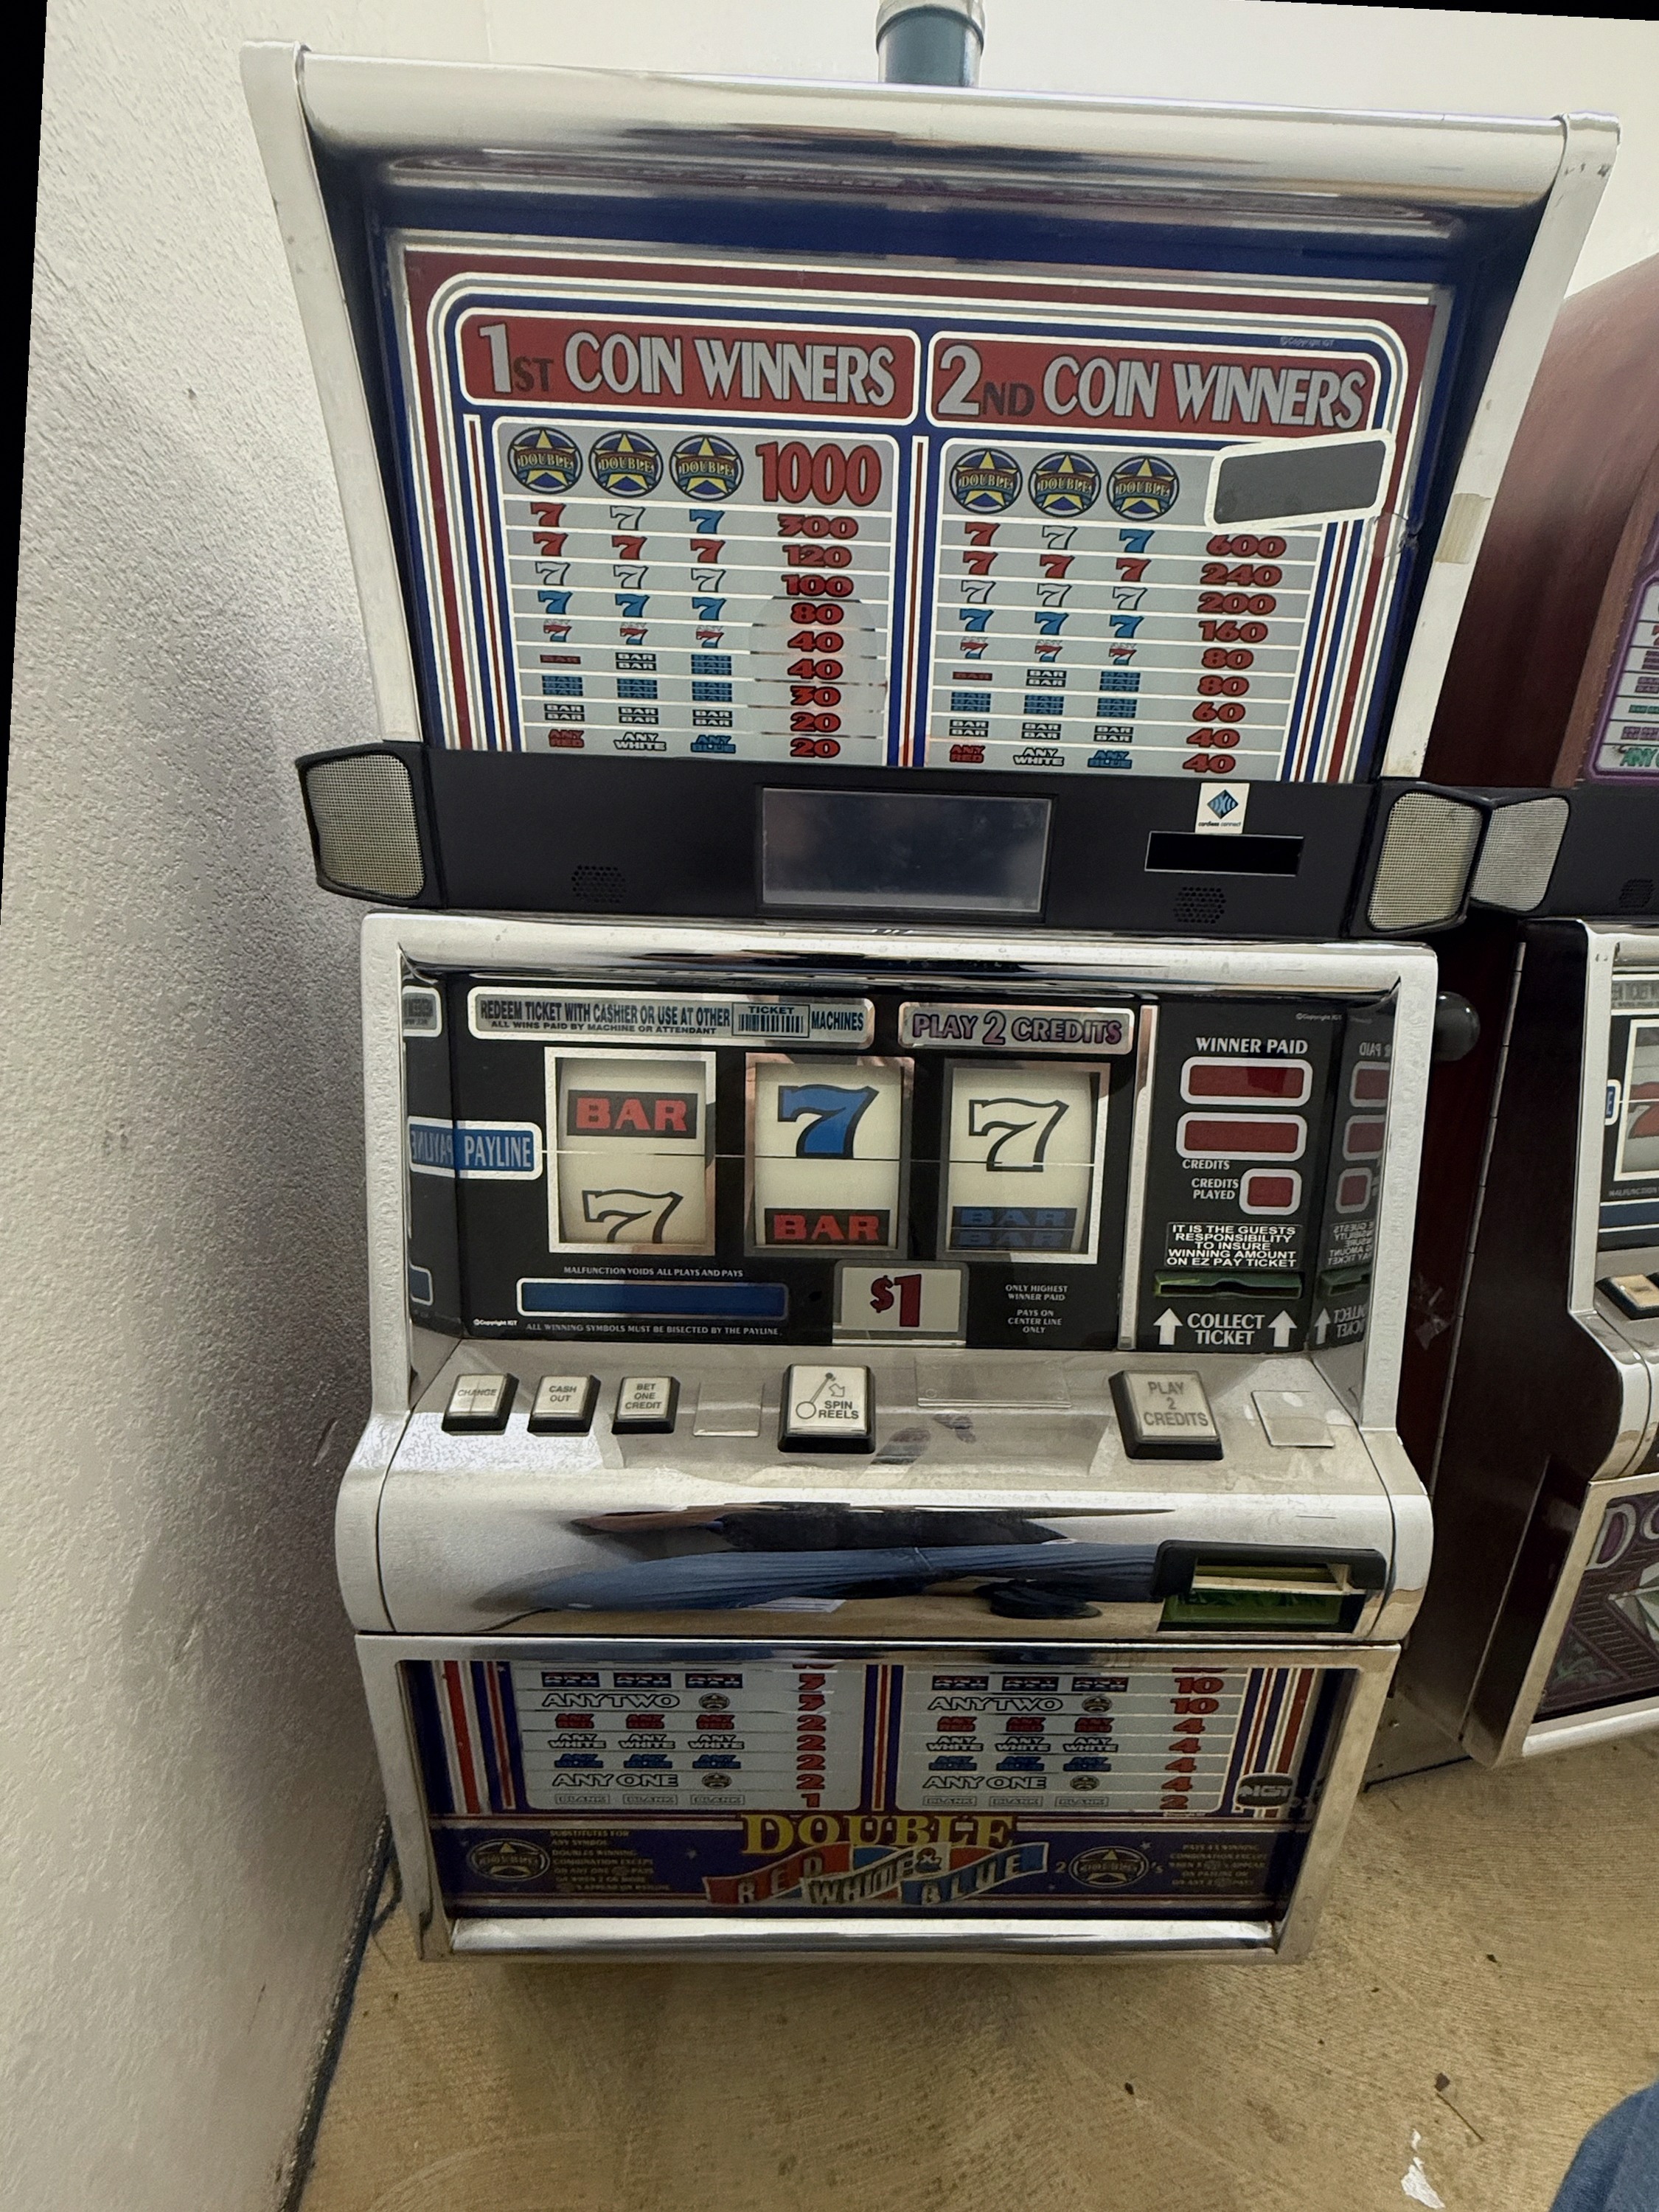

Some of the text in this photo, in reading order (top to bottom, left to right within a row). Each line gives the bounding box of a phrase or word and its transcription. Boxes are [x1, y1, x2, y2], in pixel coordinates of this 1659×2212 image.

[565, 332, 683, 395] COIN
[694, 339, 895, 406] WINNERS
[1043, 355, 1161, 419] COIN
[1173, 363, 1366, 429] WINNERS
[519, 454, 734, 476] DOUBLE DOUBLE DOUBLE
[756, 442, 881, 506] 1000
[960, 473, 1169, 497] DOUBLE DOUBLE DOUBLE
[778, 513, 858, 539] 300
[782, 544, 852, 568] 120
[1206, 535, 1287, 558] 600
[1200, 563, 1282, 587] 240
[782, 574, 854, 597] 100
[1197, 591, 1276, 616] 200
[790, 602, 844, 625] 80
[1198, 620, 1268, 643] 160
[787, 630, 844, 653] 40
[1202, 647, 1253, 670] 80
[787, 658, 843, 680] 40
[1197, 675, 1249, 696] 80
[790, 685, 841, 707] 30
[1192, 702, 1245, 723] 60
[790, 712, 841, 733] 20
[613, 740, 667, 751] WHITE
[623, 731, 658, 741] ANY
[1186, 728, 1240, 748] 40
[790, 737, 841, 758] 20
[1023, 748, 1058, 757] ANY
[1093, 750, 1130, 759] ANY
[1013, 756, 1064, 767] WHITE
[1183, 754, 1236, 773] 40
[481, 1001, 730, 1027] REDEEM TICKET WITH CASHIER OR USE AT OTHER
[748, 1006, 794, 1015] TICKET
[655, 1026, 716, 1034] ATTENDANT
[812, 1011, 864, 1031] MACHINES
[913, 1010, 1122, 1046] PLAY 2 CREDITS
[1196, 1037, 1308, 1054] WINNER PAID
[575, 1097, 687, 1133] BAR
[776, 1083, 880, 1158] 7
[967, 1098, 1070, 1172] 7
[465, 1135, 531, 1167] PAYLINE
[1182, 1159, 1230, 1169] CREDITS
[1192, 1178, 1239, 1189] CREDITS
[1193, 1190, 1236, 1200] PLAYED
[582, 1188, 684, 1245] 7
[959, 1208, 1070, 1228] BAR
[773, 1213, 879, 1245] BAR
[1172, 1225, 1296, 1234] IT IS THE GUESTS
[1175, 1234, 1293, 1243] RESPONSIBILITY
[957, 1230, 1068, 1249] BAR
[1218, 1242, 1271, 1251] INSURE
[1168, 1249, 1231, 1258] WINNING
[1192, 1258, 1209, 1266] EZ
[1214, 1259, 1243, 1267] PAY
[1247, 1259, 1296, 1267] TICKET
[563, 1266, 626, 1275] MALFUNCTION
[870, 1274, 922, 1327] $1
[1187, 1313, 1265, 1330] COLLECT
[1195, 1330, 1255, 1345] TICKET
[457, 1388, 497, 1397] CHANGE
[549, 1385, 577, 1394] CASH
[1147, 1382, 1184, 1394] PLAY
[625, 1401, 662, 1410] CREDIT
[824, 1401, 852, 1410] SPIN
[1167, 1397, 1176, 1409] 2
[818, 1410, 859, 1419] REELS
[1144, 1412, 1209, 1426] CREDITS
[1175, 1677, 1224, 1694] 10
[1170, 1697, 1220, 1714] 10
[797, 1715, 826, 1731] 2
[1172, 1717, 1206, 1733] 4
[1063, 1744, 1119, 1753] WHITE
[552, 1774, 678, 1787] ANY ONE
[796, 1774, 825, 1790] 2
[923, 1776, 1047, 1789] ANY ONE
[1161, 1776, 1193, 1791] 4
[801, 1793, 820, 1808] 1
[1159, 1795, 1189, 1810] 2
[740, 1814, 1015, 1856] DOUBLE
[916, 1848, 942, 1871] &
[739, 1854, 822, 1904] RED
[811, 1856, 915, 1903] WHITE
[922, 1854, 1023, 1905] BLUE
